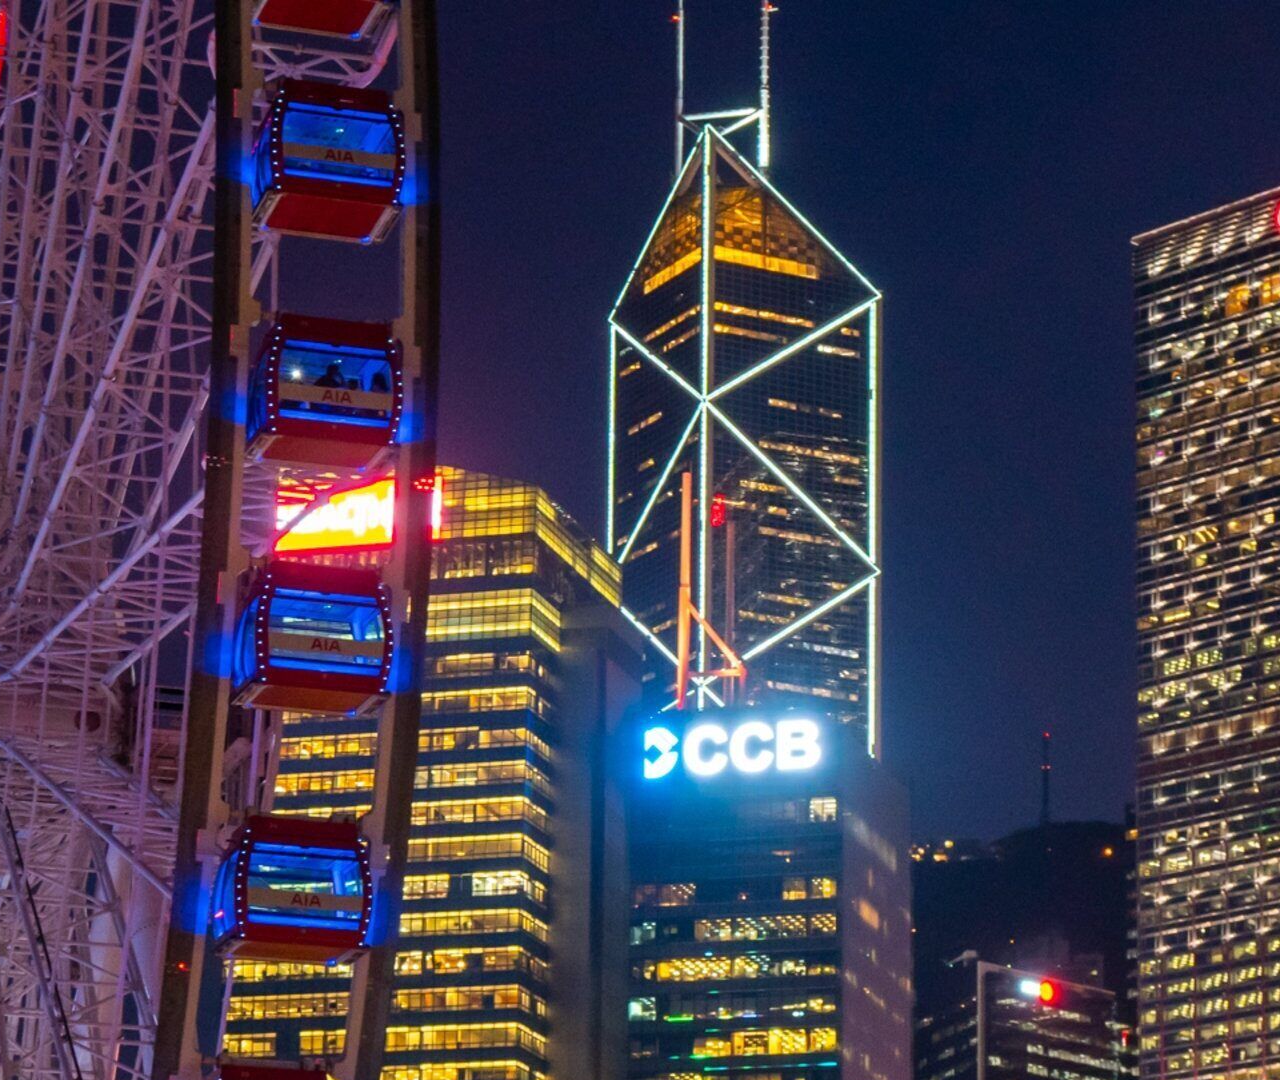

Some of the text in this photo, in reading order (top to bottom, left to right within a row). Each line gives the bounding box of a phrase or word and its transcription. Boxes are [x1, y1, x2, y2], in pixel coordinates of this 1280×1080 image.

[324, 149, 354, 163] AIA
[322, 389, 352, 404] AIA
[310, 638, 341, 652] AIA
[682, 718, 822, 777] CCB
[290, 893, 321, 907] AIA
